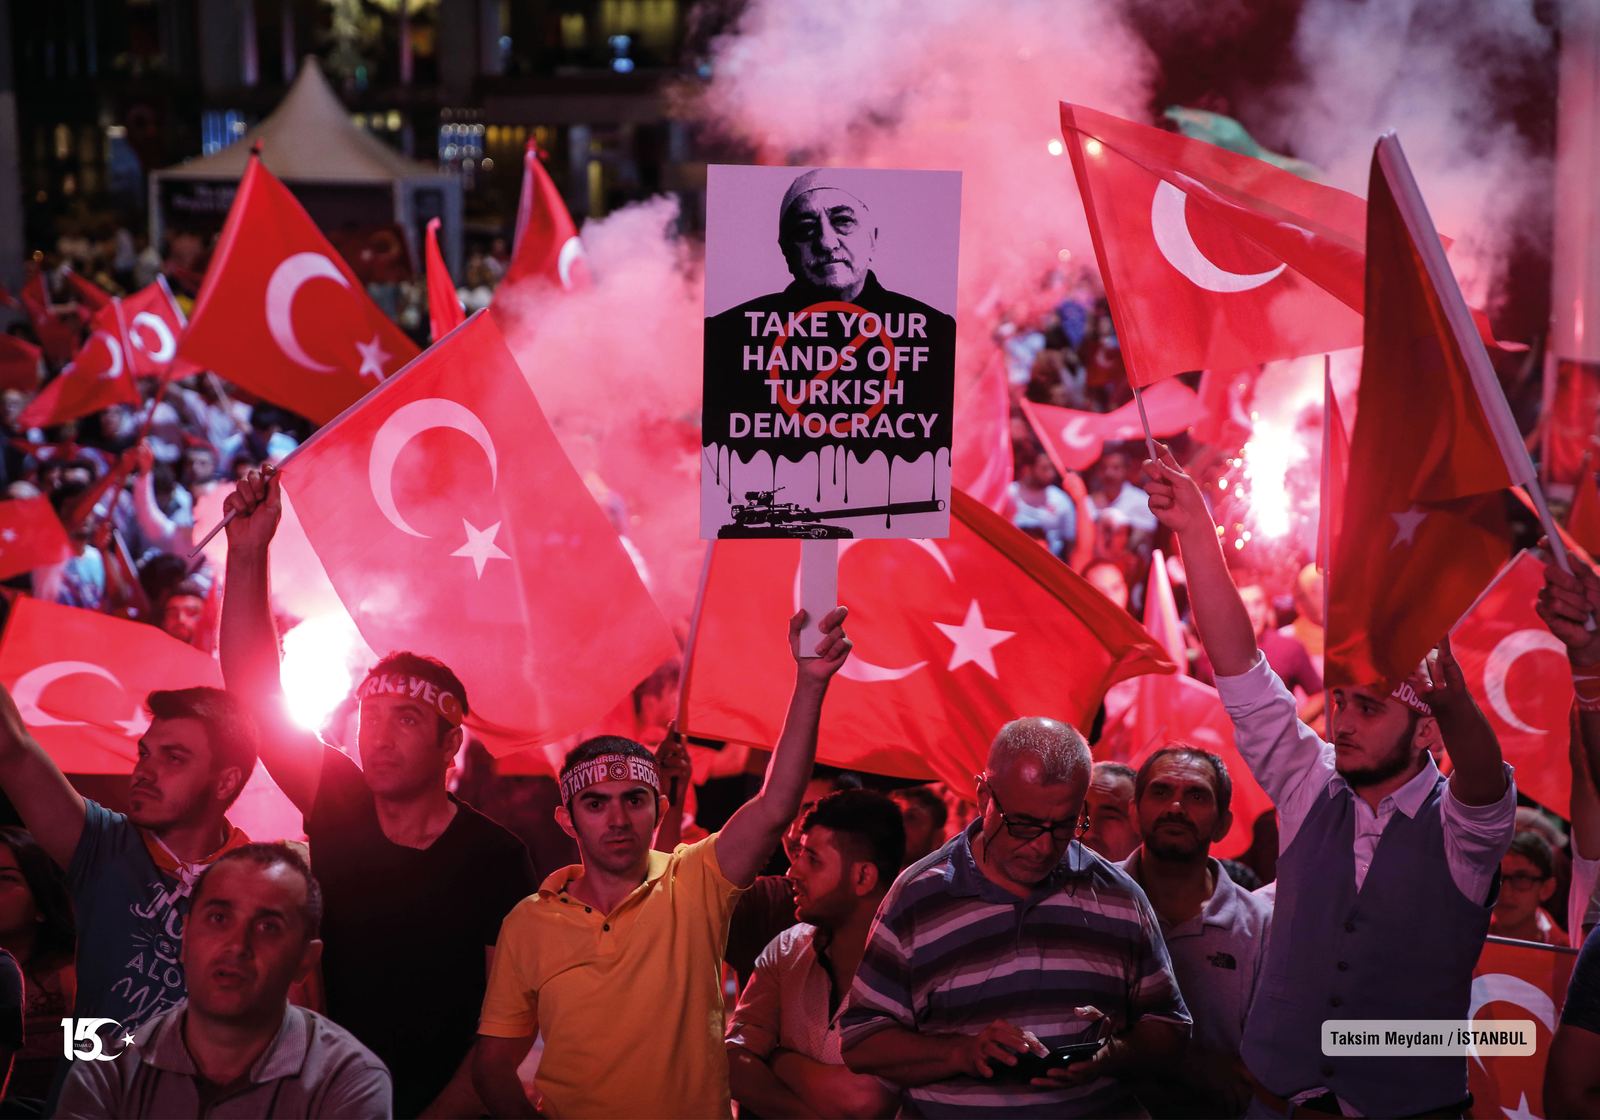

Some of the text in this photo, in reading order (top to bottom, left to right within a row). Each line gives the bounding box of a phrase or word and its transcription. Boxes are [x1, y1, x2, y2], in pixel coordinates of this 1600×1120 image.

[744, 311, 928, 338] TAKE YOUR
[743, 345, 930, 372] HANDS OFF
[764, 379, 904, 405] TURKISH
[729, 413, 939, 439] DEMOCRACY
[125, 952, 187, 991] ALO
